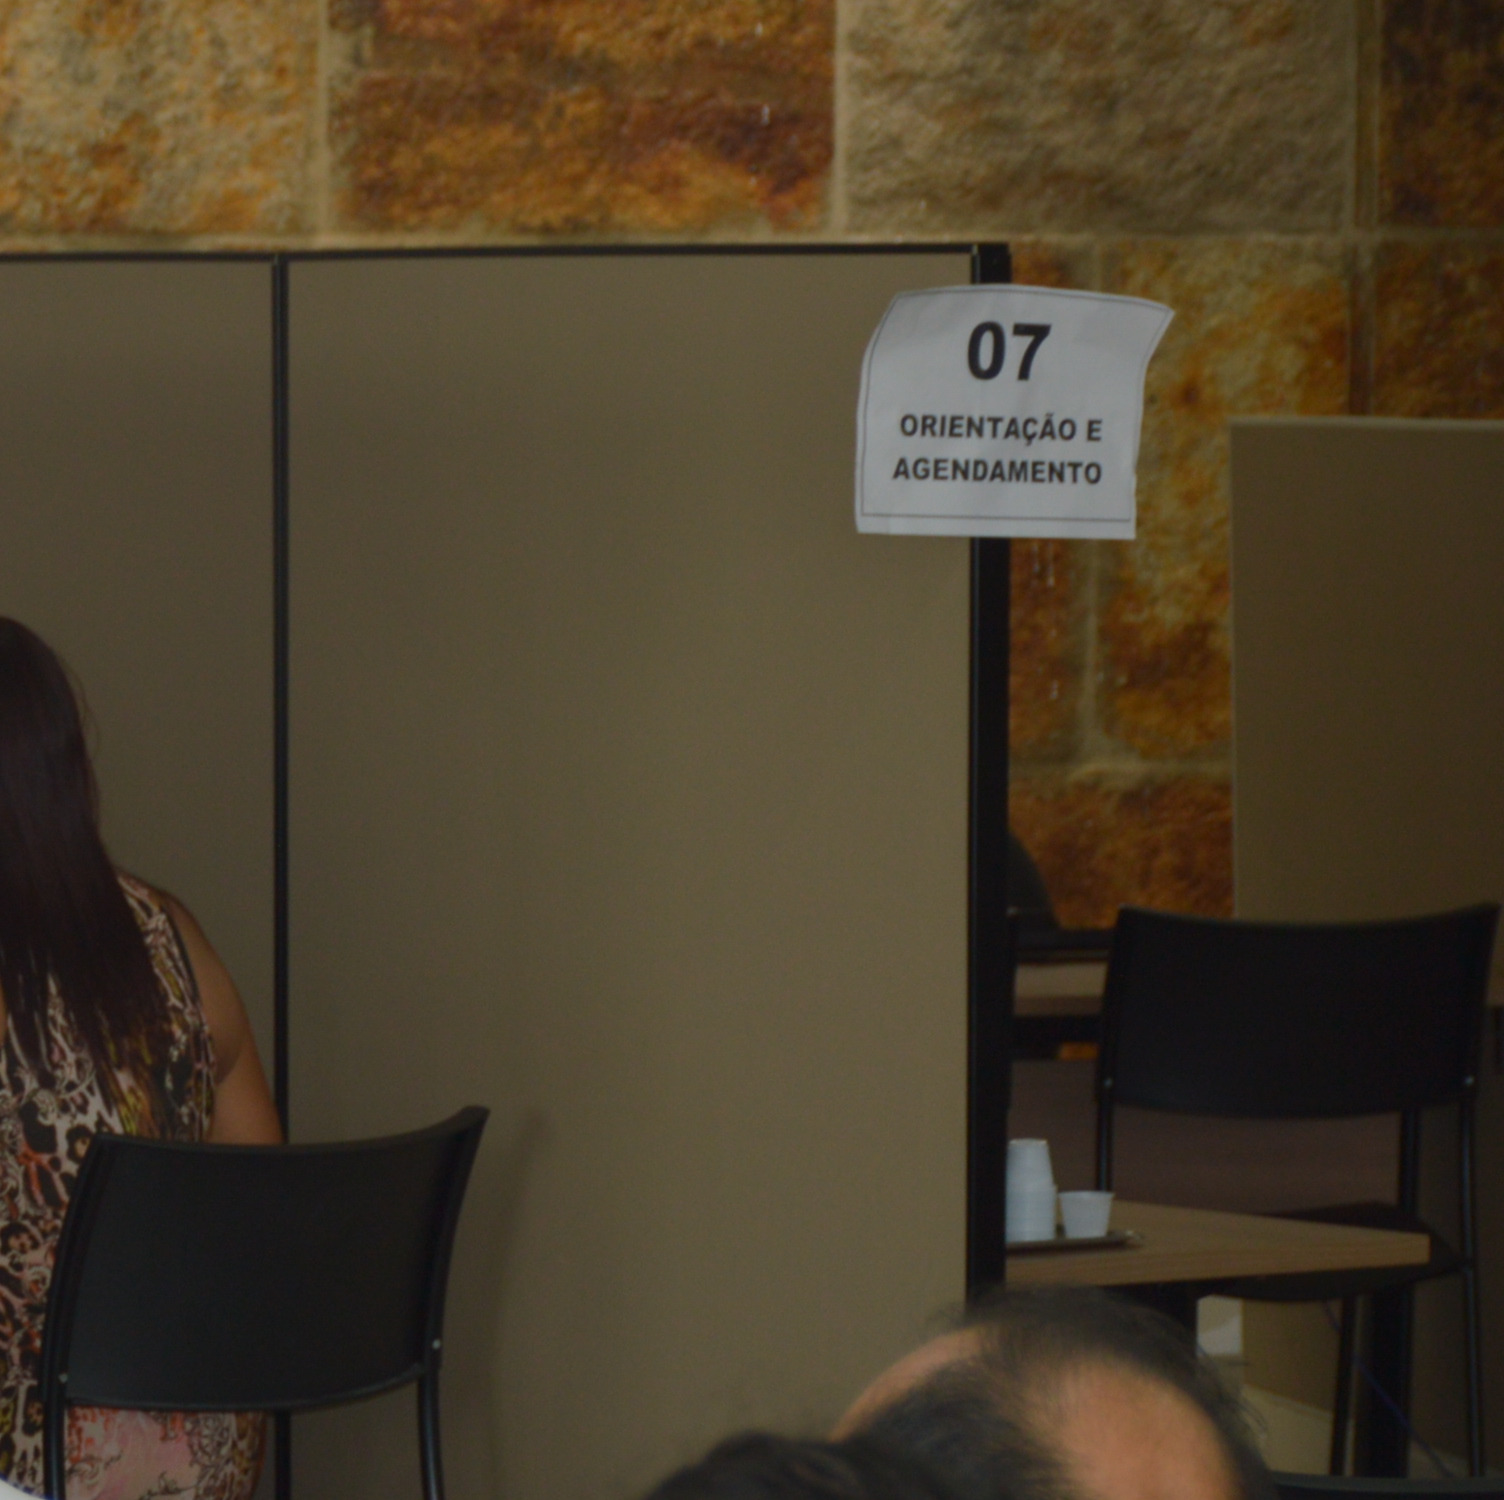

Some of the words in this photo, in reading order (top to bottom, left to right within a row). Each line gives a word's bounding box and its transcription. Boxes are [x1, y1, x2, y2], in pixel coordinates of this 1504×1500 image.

[967, 320, 1052, 381] 07
[900, 413, 1077, 446] ORIENTAÇÃO
[1087, 419, 1103, 442] E
[893, 457, 1102, 485] AGENDAMENTO
